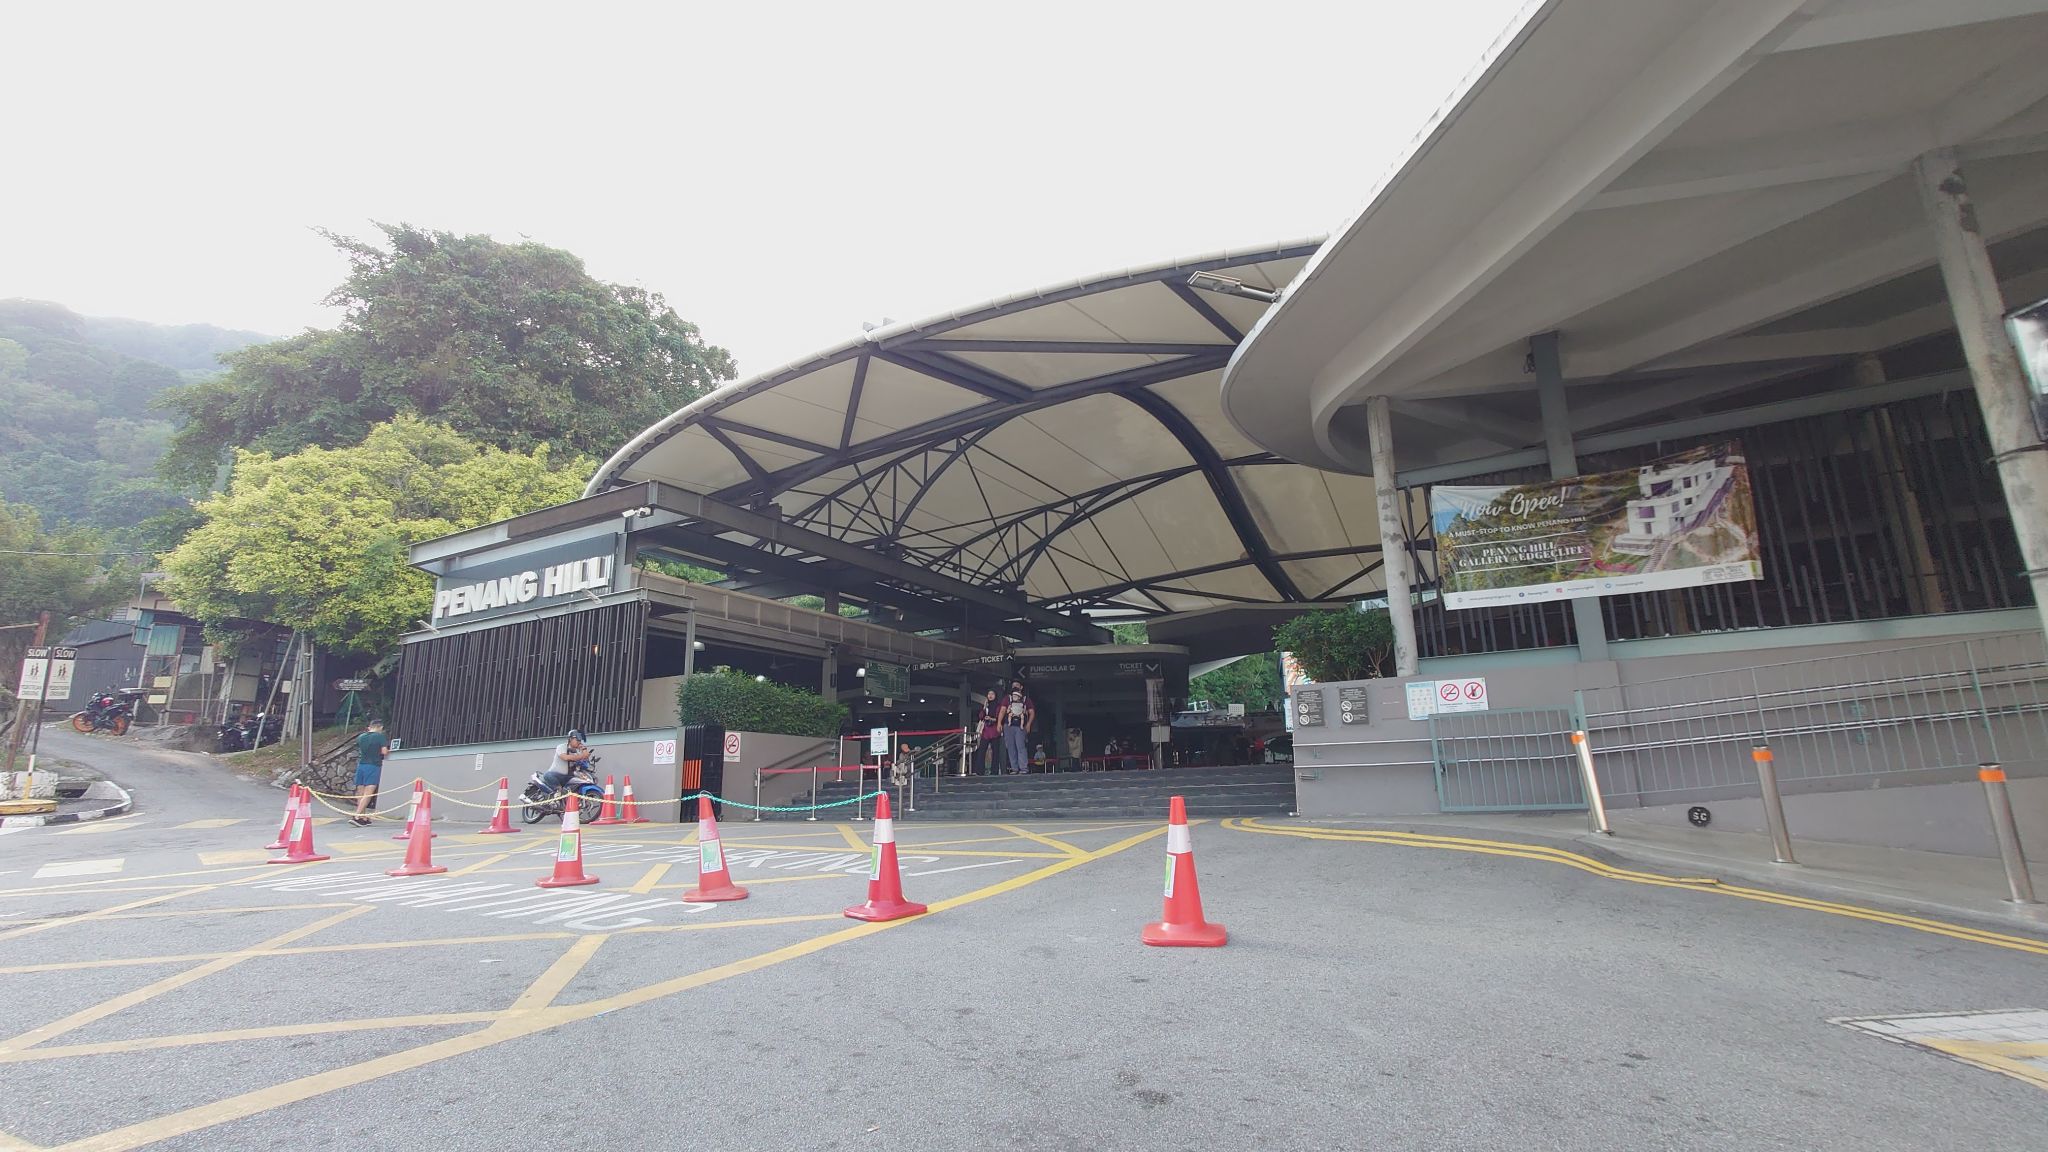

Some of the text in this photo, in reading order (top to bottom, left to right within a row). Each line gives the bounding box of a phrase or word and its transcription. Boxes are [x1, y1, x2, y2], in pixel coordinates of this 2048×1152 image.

[1461, 486, 1567, 521] Now Open!
[1455, 527, 1499, 538] MUST-STOP
[1512, 522, 1536, 532] KNOW
[1537, 518, 1570, 529] PENANG
[1482, 542, 1555, 558] PENANG HILL
[1459, 555, 1509, 567] GALLERY
[434, 554, 613, 619] PENANG HILL
[27, 648, 49, 657] SLOW
[55, 649, 76, 659] SLOW
[920, 662, 935, 670] INFO
[981, 654, 1004, 664] TICKET
[1030, 662, 1143, 673] FUNICULAR TICKET
[229, 871, 717, 930] NO WAITING
